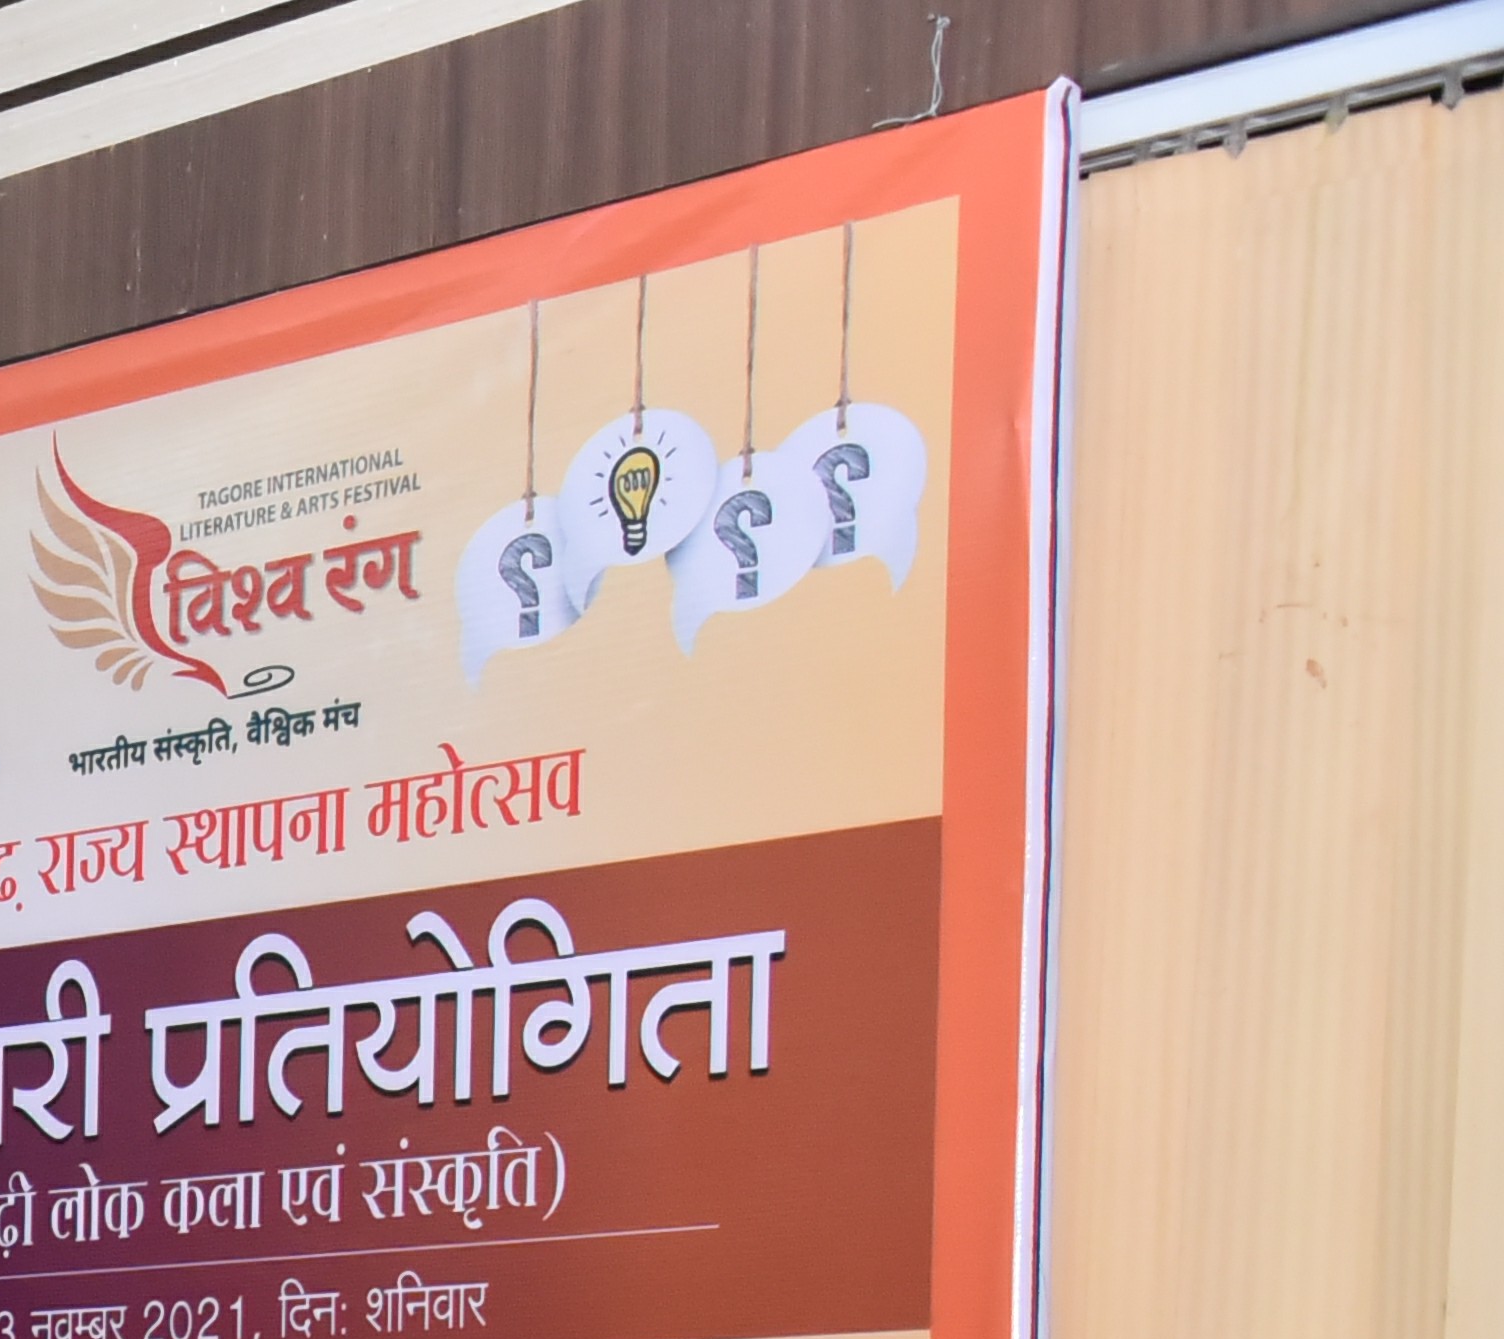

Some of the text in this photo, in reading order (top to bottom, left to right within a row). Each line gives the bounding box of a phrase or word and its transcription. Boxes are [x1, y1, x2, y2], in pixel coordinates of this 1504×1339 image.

[180, 473, 422, 541] LITERATURE & ARTS FESTIVAL
[198, 448, 404, 509] TAGORE INTERNATIONAL
[164, 515, 421, 644] विश्व रंग
[69, 698, 361, 774] भारतीय संस्कृति, वैश्विक मंच
[36, 818, 148, 897] राज्य
[163, 786, 351, 877] स्थापना
[365, 743, 586, 844] महोत्सव
[145, 898, 786, 1134] प्रतियोगिता
[49, 1163, 148, 1242] लोक
[161, 1171, 265, 1234] कला
[279, 1137, 346, 1225] एवं
[360, 1126, 567, 1229] संस्कृति)
[279, 1278, 348, 1338] दिन:
[365, 1270, 490, 1334] शनिवार
